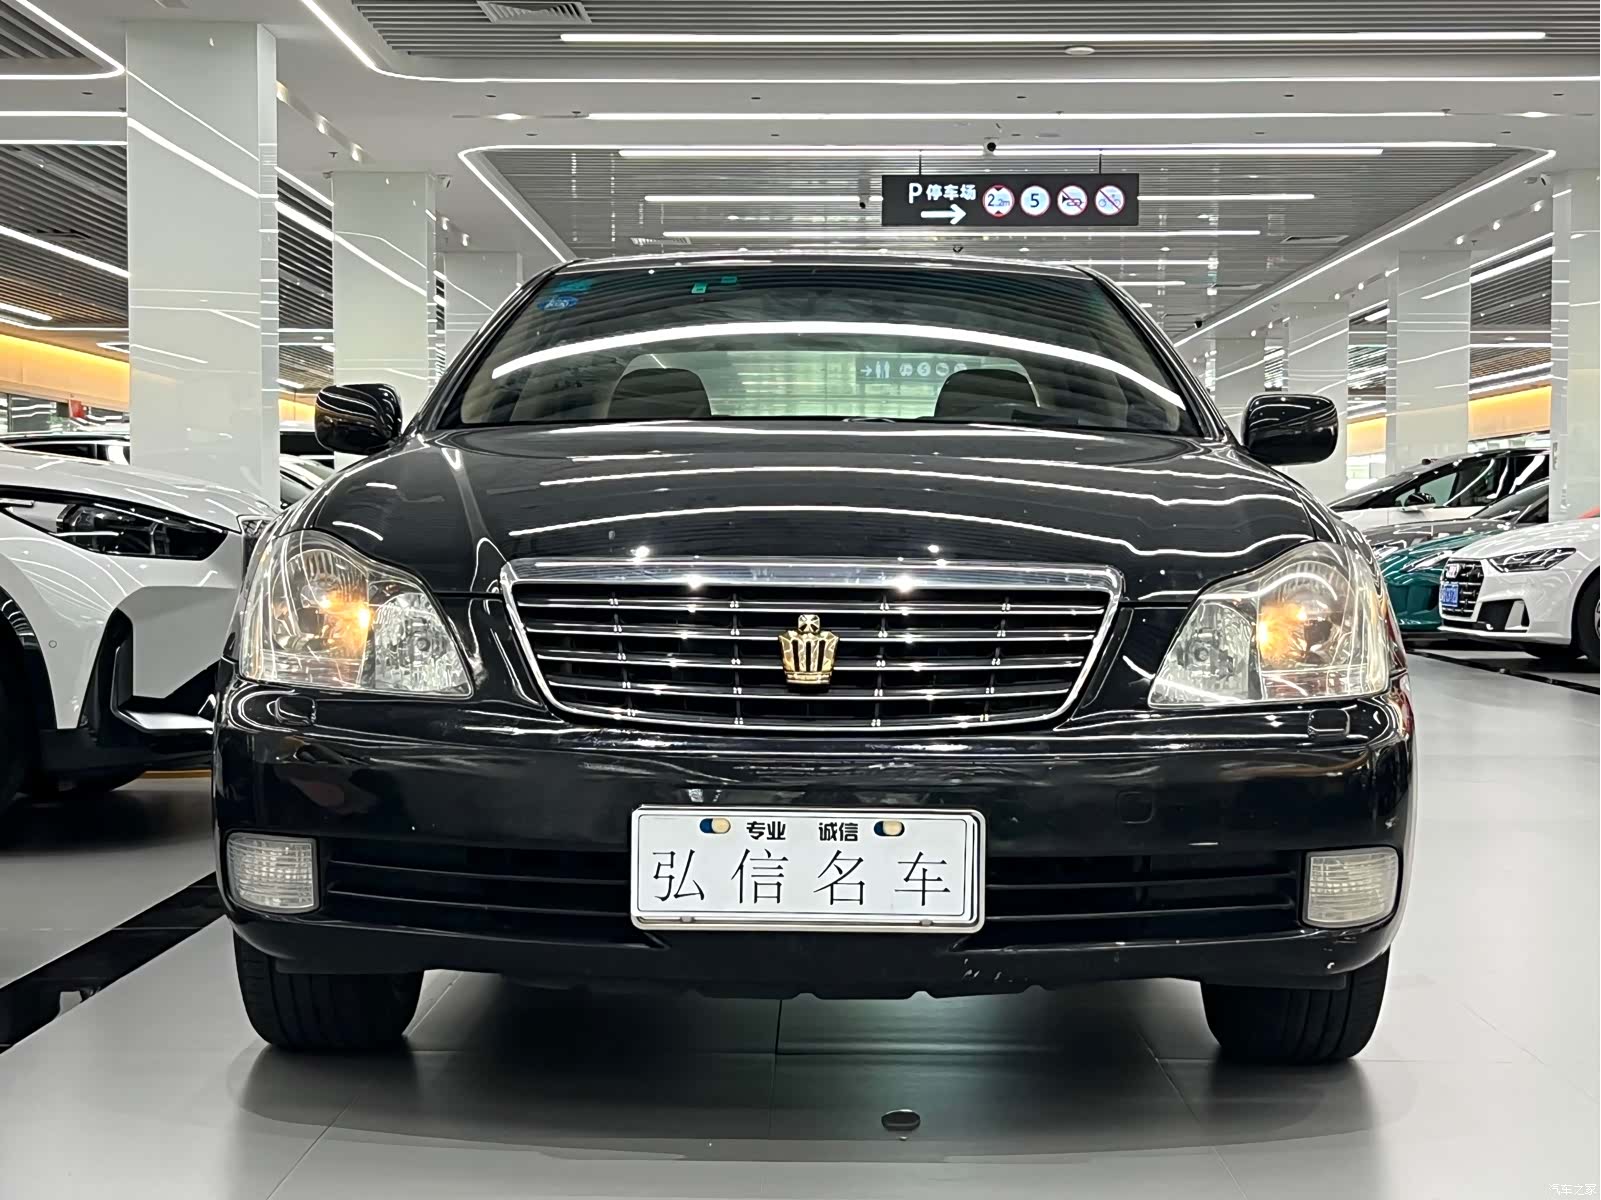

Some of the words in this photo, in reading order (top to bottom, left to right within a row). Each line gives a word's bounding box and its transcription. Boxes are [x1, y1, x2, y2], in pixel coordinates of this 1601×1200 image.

[908, 182, 923, 204] P
[926, 183, 977, 201] 停车场
[1030, 193, 1040, 208] 5
[746, 821, 787, 841] 专业
[818, 821, 859, 842] 诚信
[652, 848, 951, 906] 弘信名车
